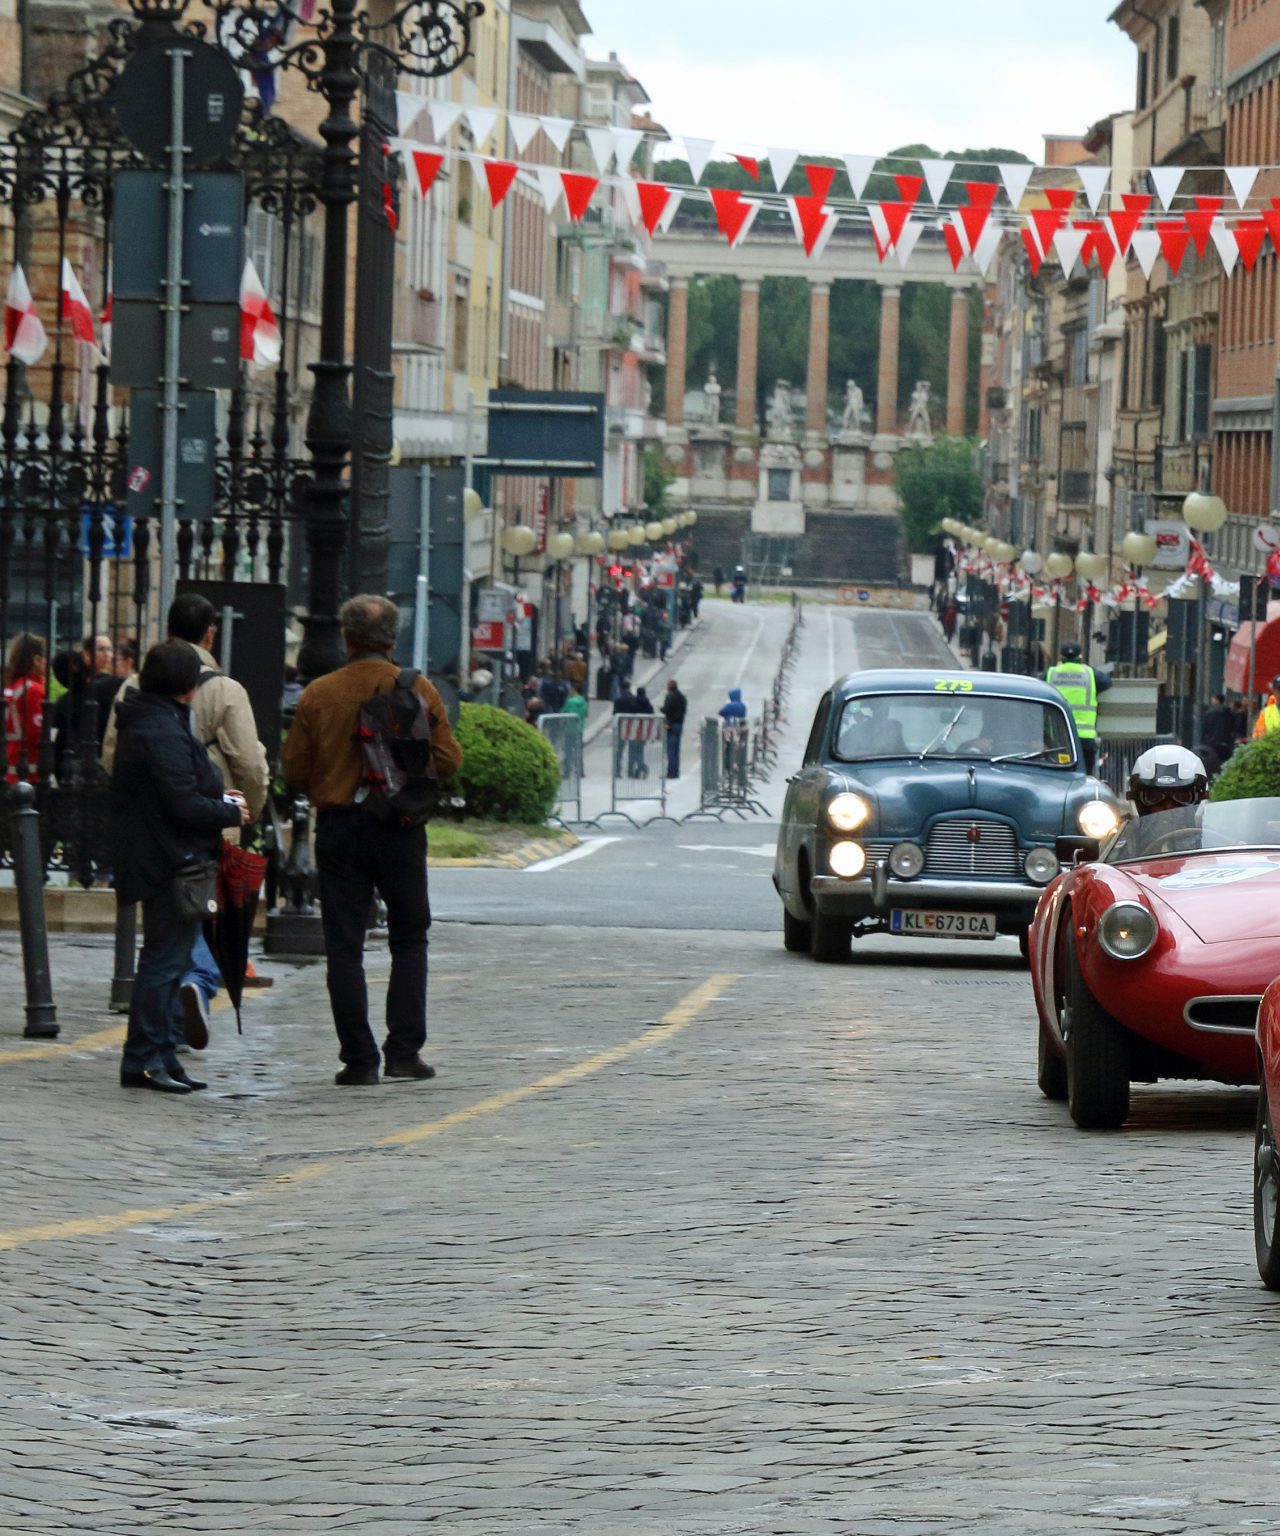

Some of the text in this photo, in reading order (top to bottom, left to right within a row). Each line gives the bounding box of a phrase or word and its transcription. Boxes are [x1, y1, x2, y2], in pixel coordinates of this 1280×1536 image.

[934, 679, 973, 691] 279
[904, 912, 990, 932] KL 673 CA
